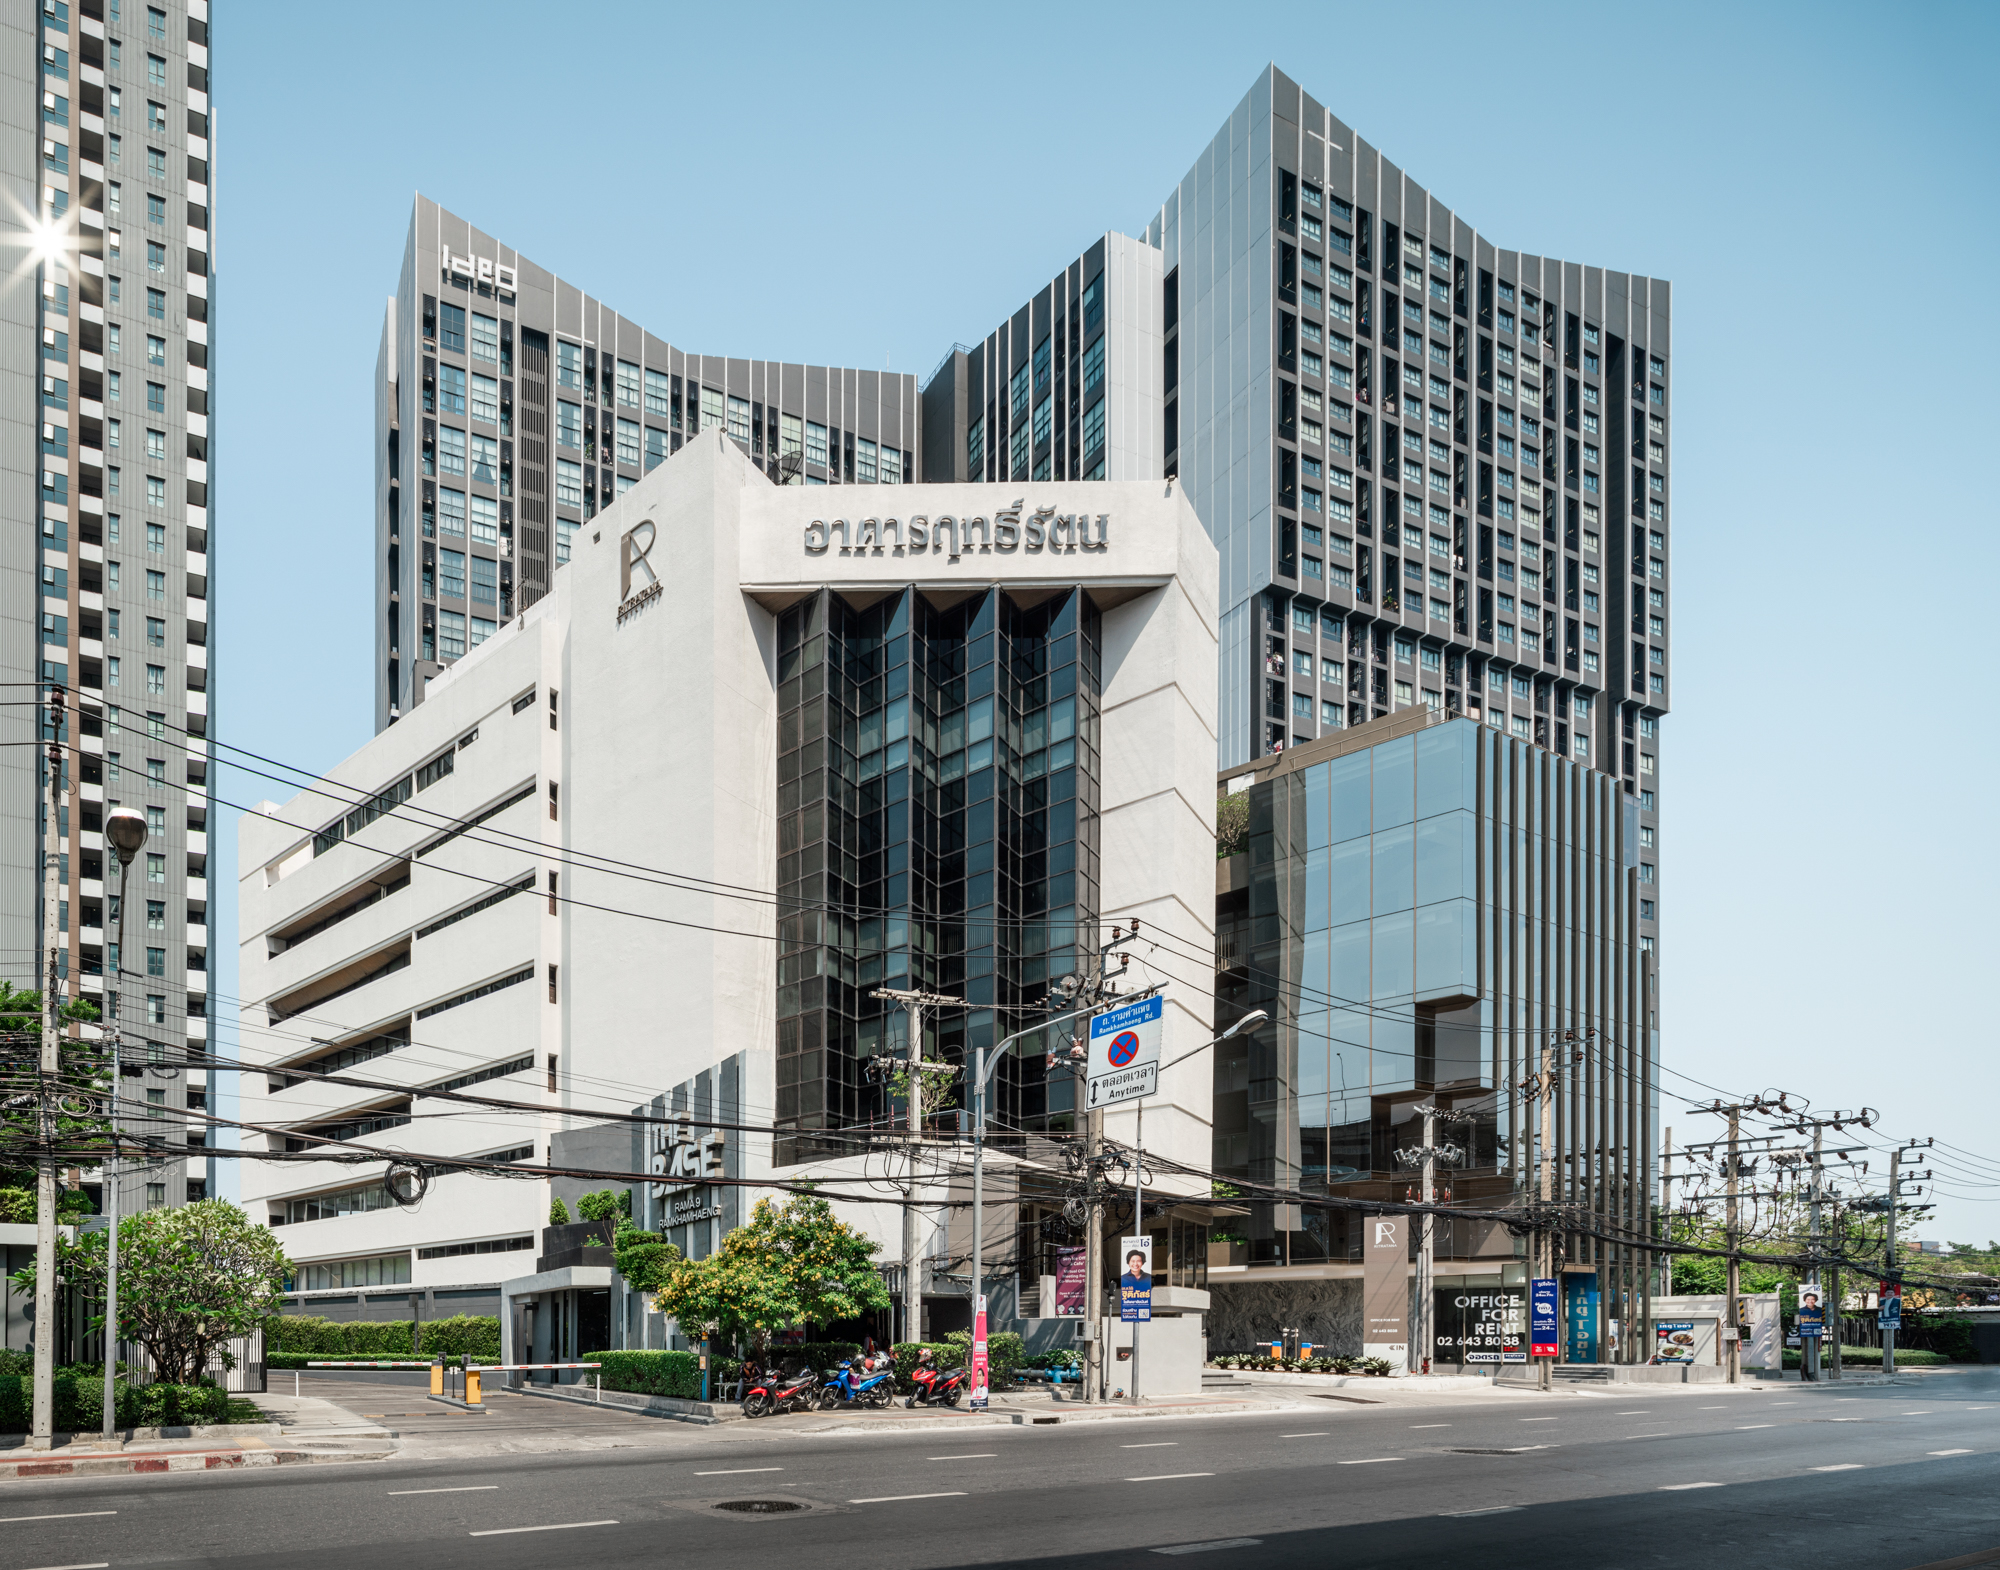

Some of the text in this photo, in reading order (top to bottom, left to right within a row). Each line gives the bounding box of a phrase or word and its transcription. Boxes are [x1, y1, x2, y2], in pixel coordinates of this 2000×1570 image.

[1111, 1003, 1151, 1022] รามคำแหง
[1099, 1012, 1154, 1034] Ramkhamhaeng Rd.
[1102, 1066, 1154, 1088] ตลอดเวลา
[11, 1095, 28, 1105] CAT
[1108, 1084, 1145, 1099] Anytime
[652, 1111, 690, 1154] THE
[652, 1132, 725, 1199] BASE
[674, 1196, 701, 1213] RAMA 9
[659, 1205, 722, 1229] RAMKHAMHAENG
[1454, 1294, 1519, 1308] OFFICE
[1482, 1309, 1518, 1321] FOR
[1475, 1323, 1519, 1335] RENT
[1437, 1337, 1519, 1346] 02 643 8038
